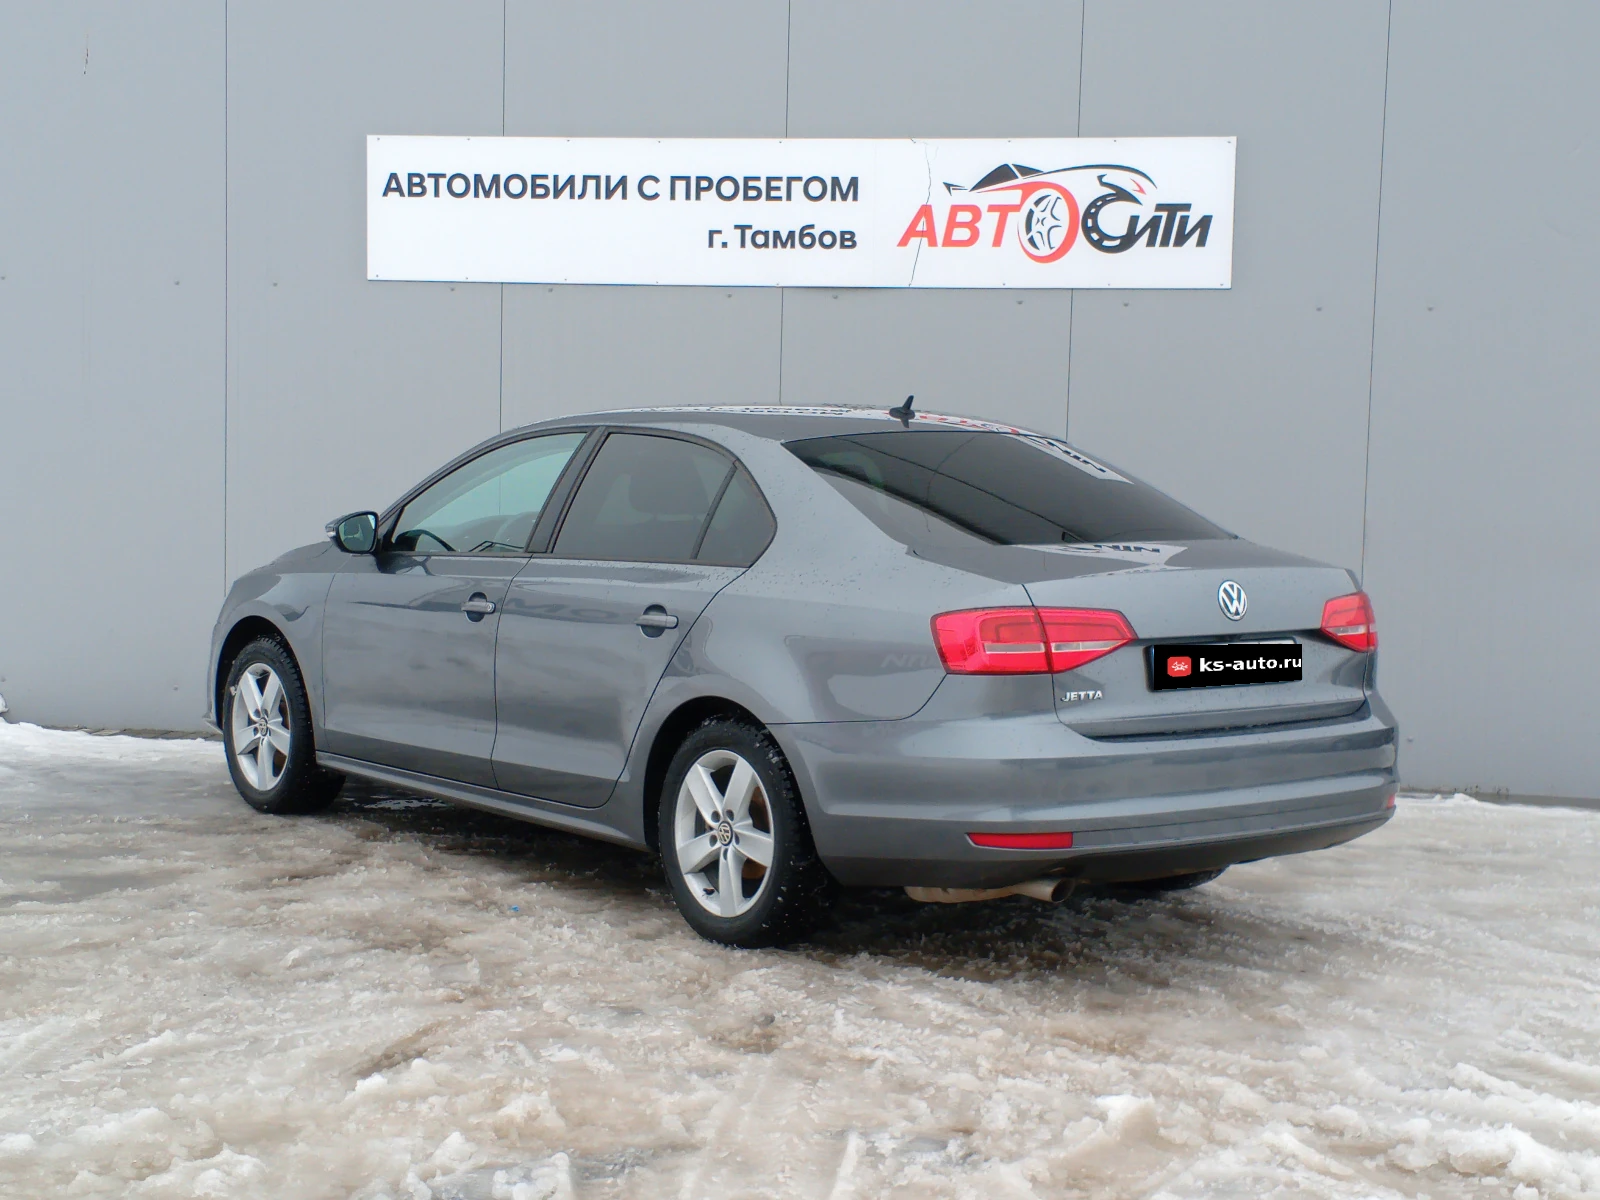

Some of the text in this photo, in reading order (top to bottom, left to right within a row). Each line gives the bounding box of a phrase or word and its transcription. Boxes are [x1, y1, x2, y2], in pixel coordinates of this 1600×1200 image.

[382, 172, 860, 203] АВТОМОБИЛИ С ПРОБЕГОМ
[707, 223, 858, 250] г. Тамбов
[1061, 689, 1103, 702] JETTA
